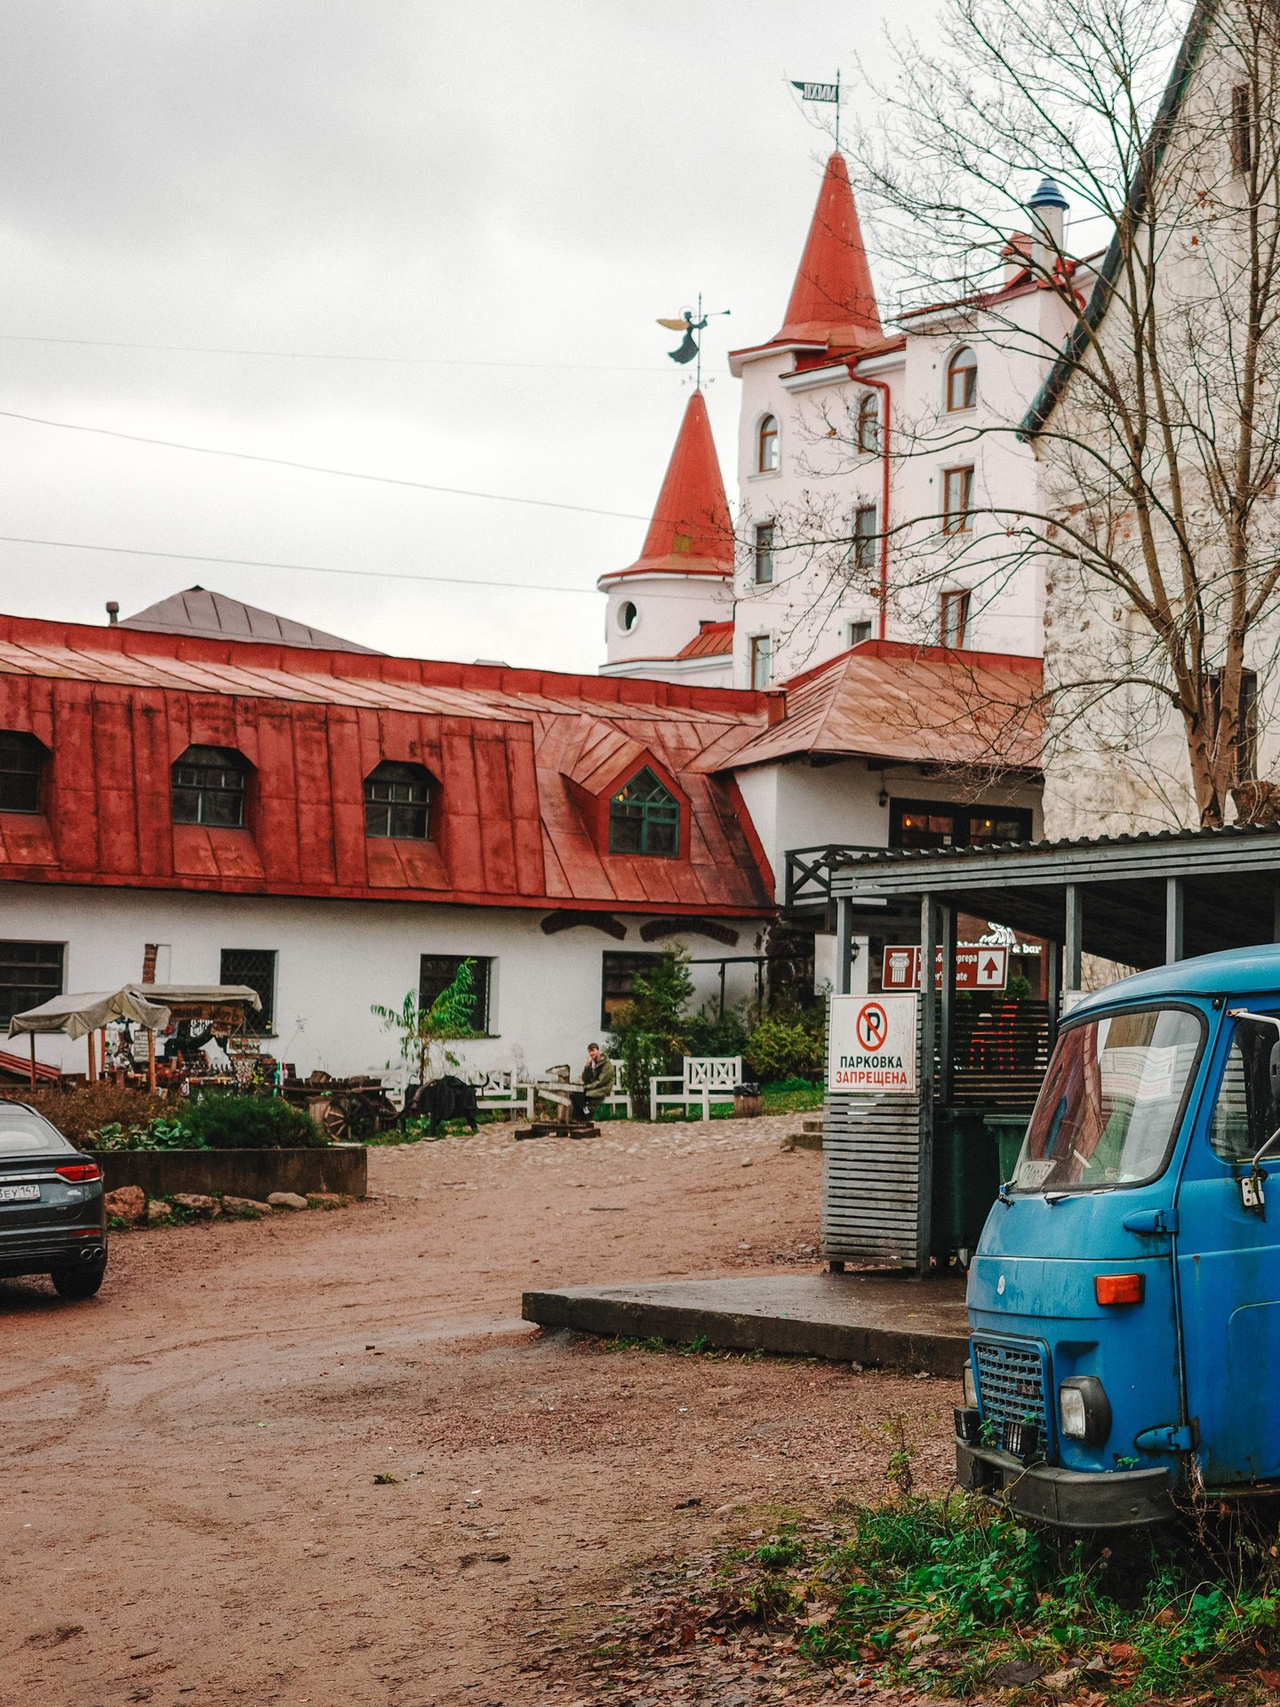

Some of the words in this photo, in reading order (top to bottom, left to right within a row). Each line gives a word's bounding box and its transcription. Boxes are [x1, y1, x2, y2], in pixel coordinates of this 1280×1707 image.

[1022, 943, 1042, 954] bar
[840, 1055, 903, 1069] ПАРКОВКА
[835, 1070, 908, 1086] ЗАПРЕЩЕНА
